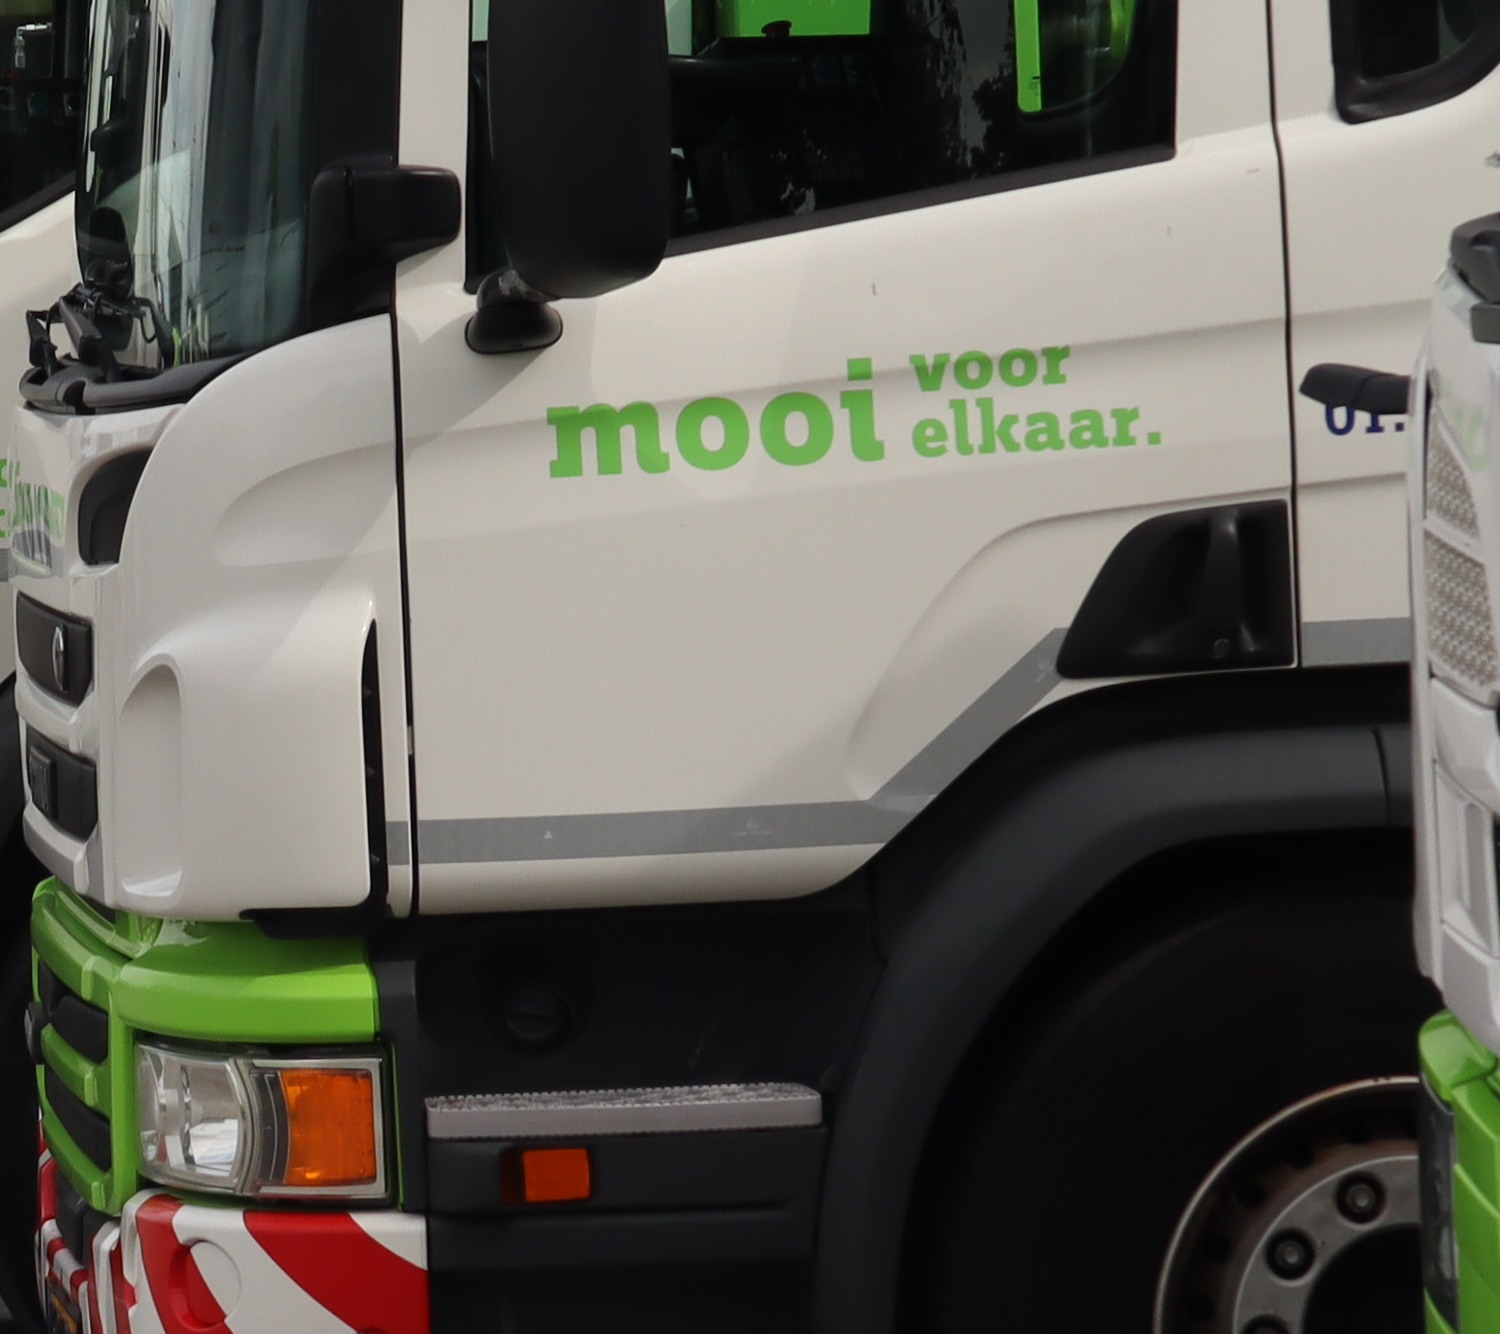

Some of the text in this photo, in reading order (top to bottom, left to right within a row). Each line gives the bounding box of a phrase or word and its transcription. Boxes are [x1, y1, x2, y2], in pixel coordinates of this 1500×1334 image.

[909, 344, 1071, 393] voor
[546, 357, 885, 479] mooi
[911, 397, 1162, 458] elkaar.
